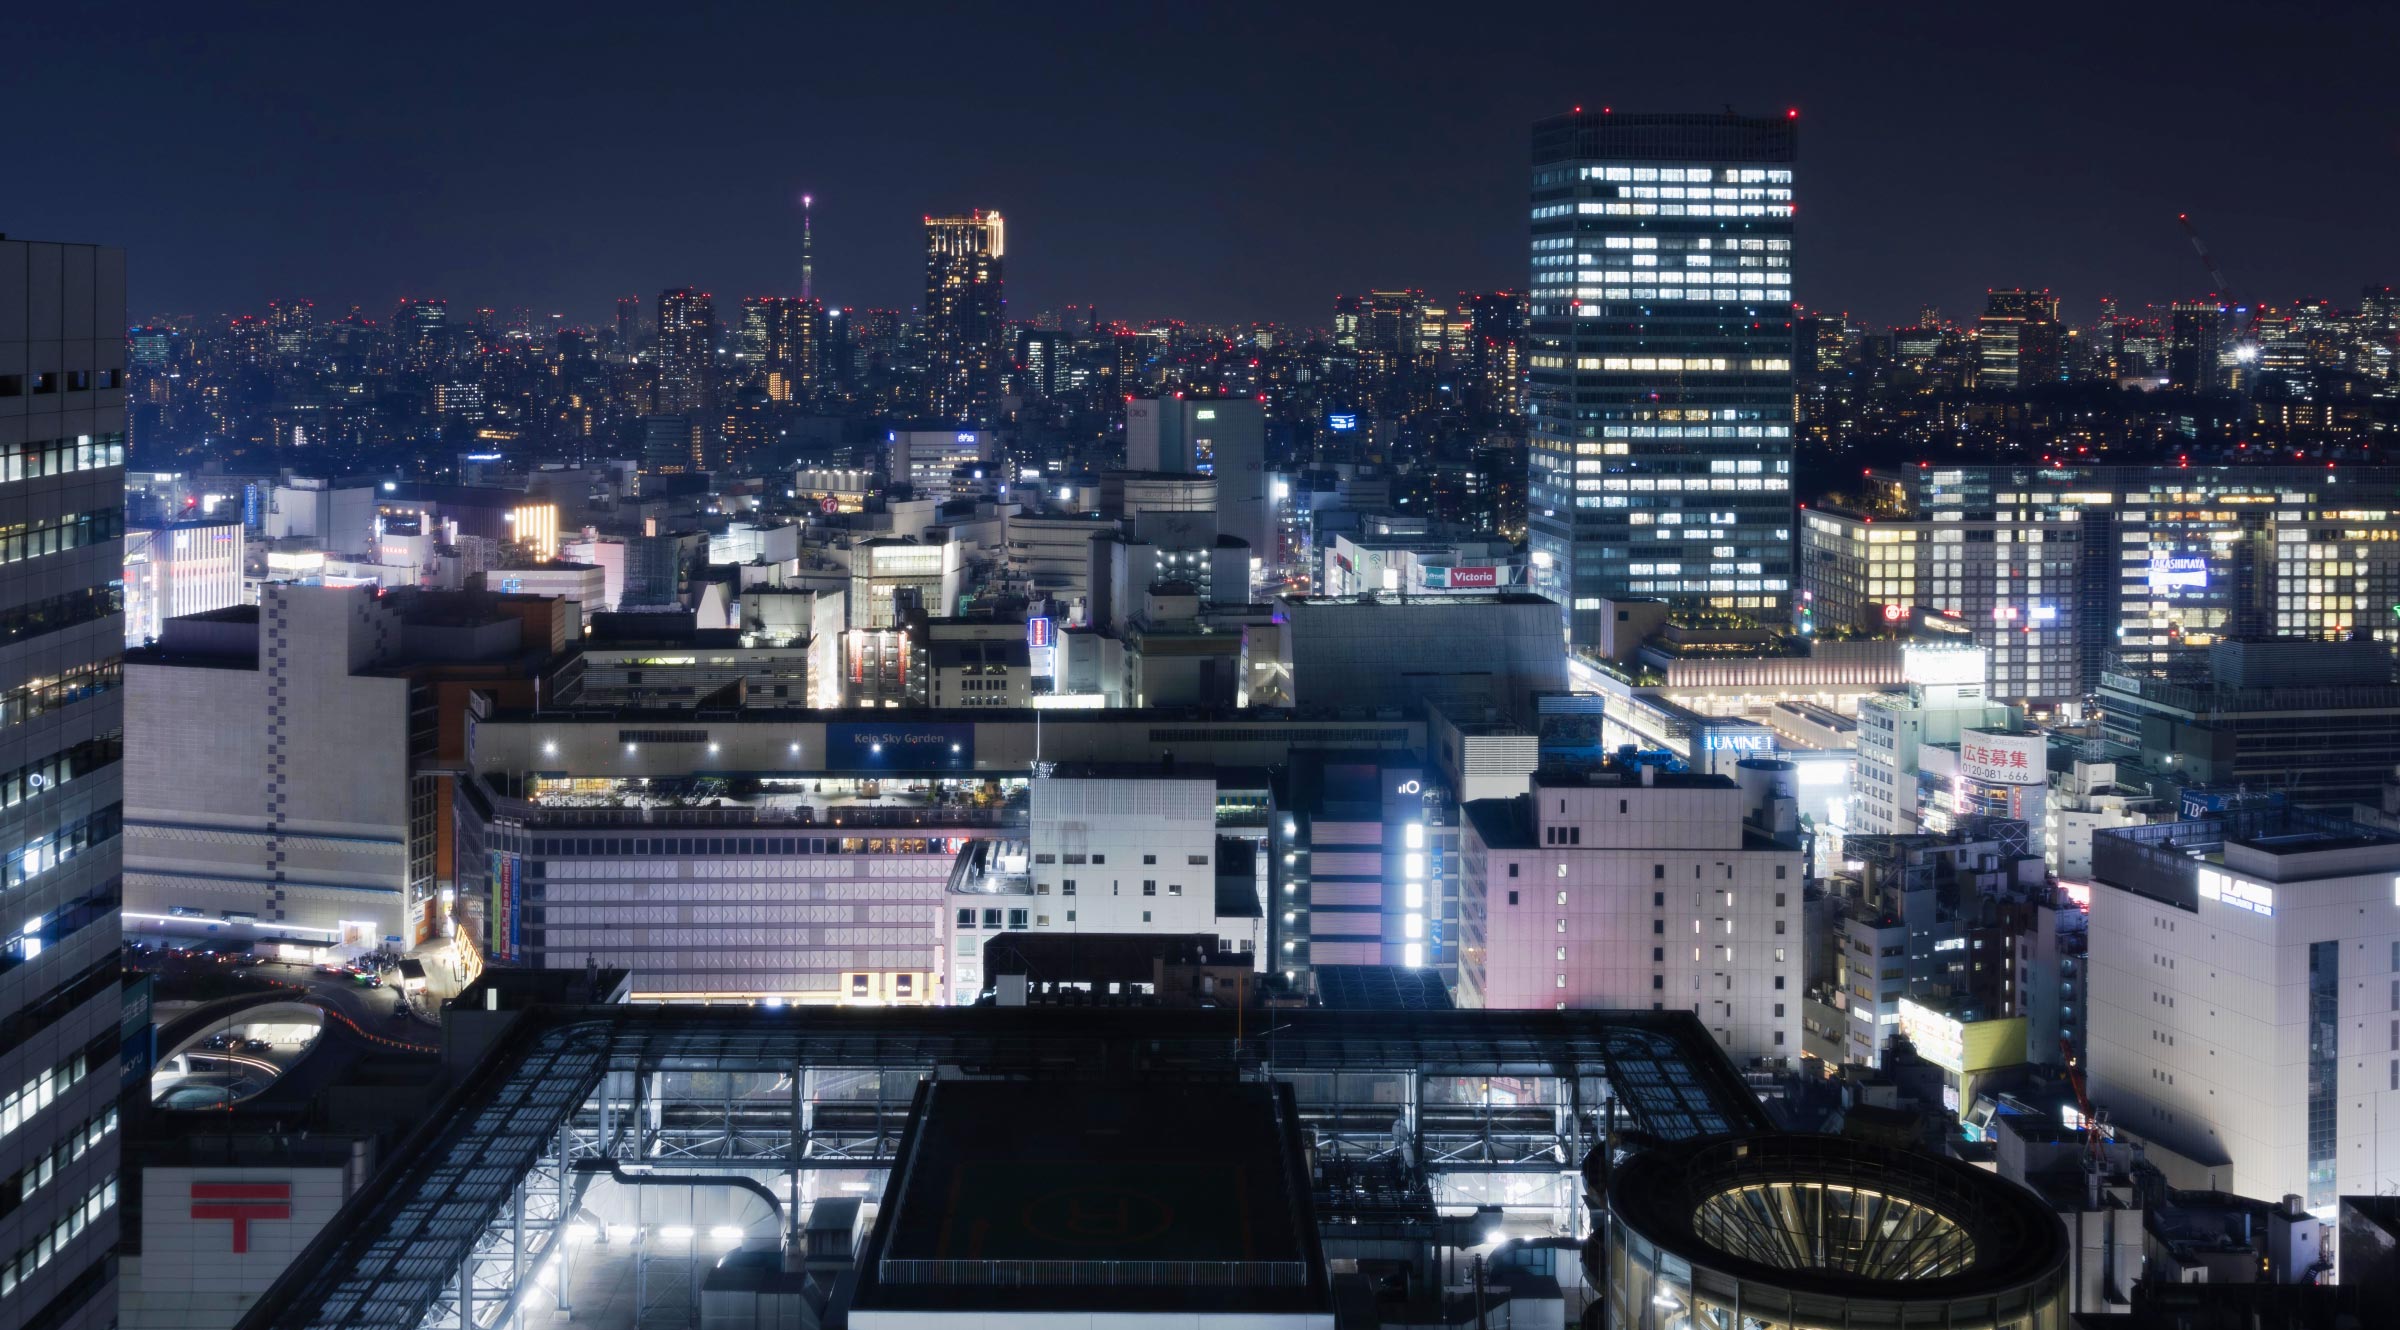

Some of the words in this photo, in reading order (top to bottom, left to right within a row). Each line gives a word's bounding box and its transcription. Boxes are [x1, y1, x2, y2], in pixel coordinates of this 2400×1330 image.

[2149, 558, 2206, 570] TAKASHIMAYA
[1454, 572, 1492, 582] Victoria
[882, 733, 901, 745] Sky
[904, 734, 944, 744] Garden
[1707, 736, 1762, 750] LUMINE
[1765, 736, 1771, 750] 1
[1963, 744, 2028, 769] 広告募集
[1962, 763, 2029, 782] 0120-081-666
[1432, 867, 1442, 878] P
